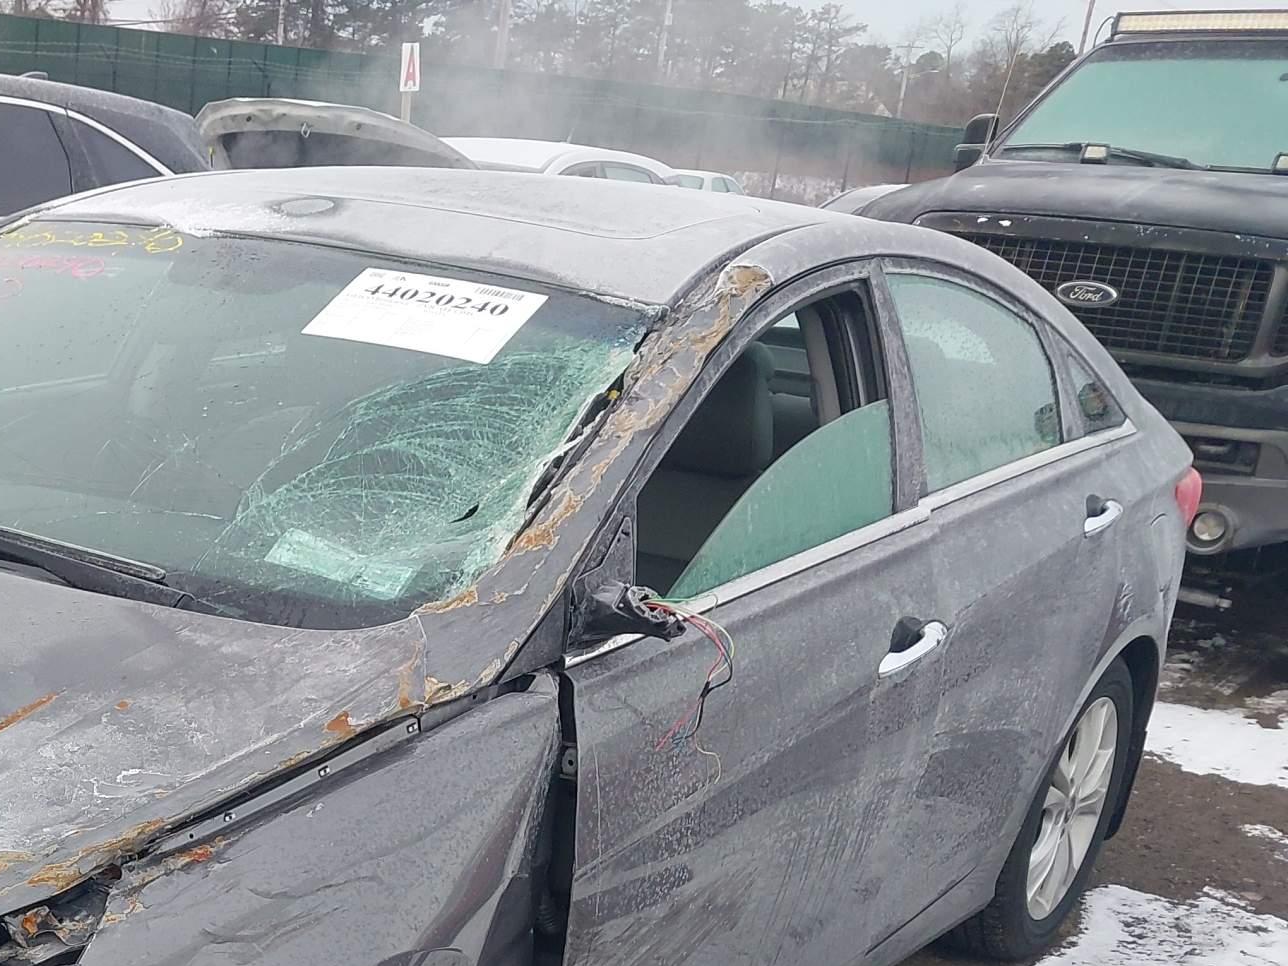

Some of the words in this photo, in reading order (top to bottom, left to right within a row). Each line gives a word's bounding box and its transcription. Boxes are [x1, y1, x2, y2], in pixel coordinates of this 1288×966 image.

[403, 44, 417, 88] A
[363, 283, 510, 317] 44020240
[1069, 285, 1105, 302] Ford
